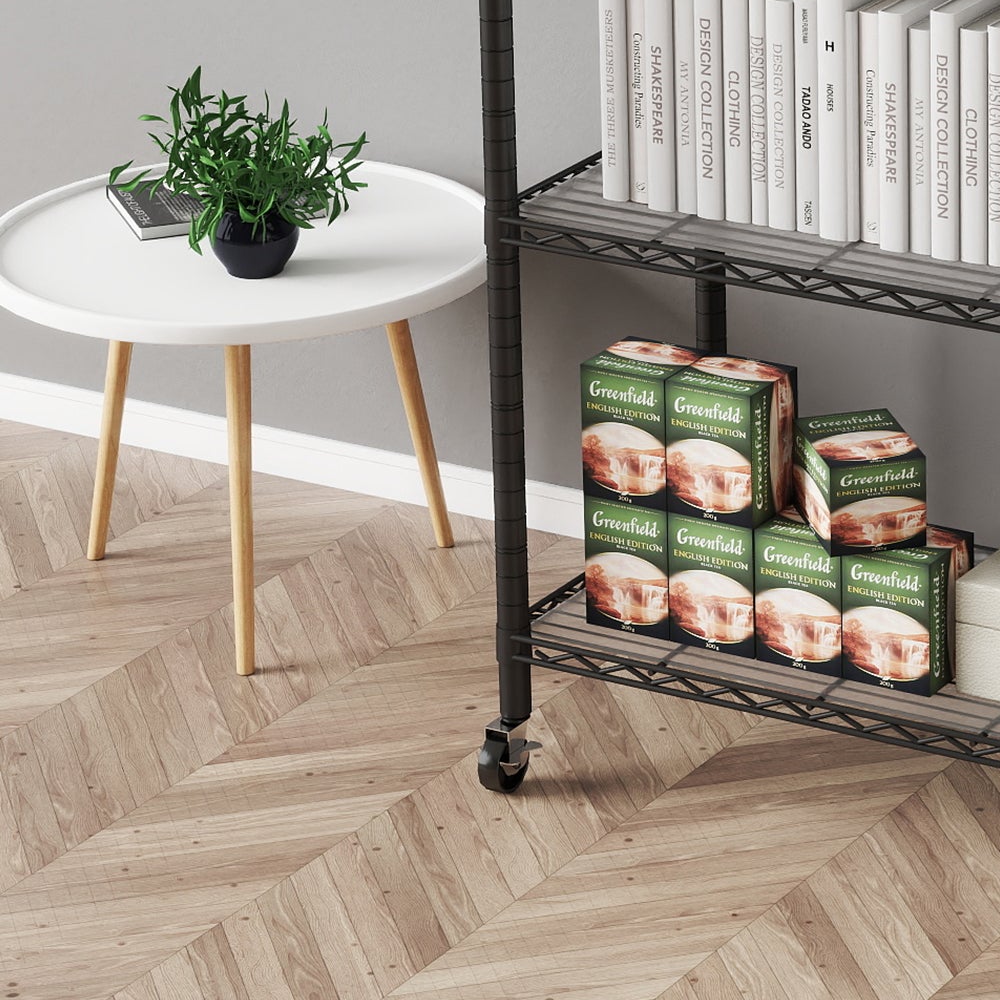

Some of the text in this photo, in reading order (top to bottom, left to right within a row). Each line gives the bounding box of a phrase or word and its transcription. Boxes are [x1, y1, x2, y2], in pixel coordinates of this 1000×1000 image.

[632, 32, 643, 90] Constructing
[680, 60, 689, 82] MY
[605, 9, 616, 168] THE THREE MUSKETEERS
[651, 45, 663, 145] SHAKESPEARE
[699, 18, 713, 179] DESIGN COLLECTION
[826, 83, 834, 112] HOUSES
[864, 69, 876, 127] Constructing
[728, 70, 741, 148] CLOTHING
[750, 35, 767, 184] DESIGN COLLECTION
[772, 43, 785, 190] DESIGN COLLECTION
[801, 86, 812, 150] TADAO ANDO
[885, 82, 897, 184] SHAKESPEARE
[915, 98, 924, 186] MY ANTONIA
[936, 54, 949, 220] DESIGN COLLECTION
[965, 108, 978, 187] CLOTHING
[804, 200, 812, 226] TASCEN
[589, 380, 657, 407] Greenfield
[586, 401, 661, 422] ENGLISH EDITION
[674, 396, 743, 424] Greenfield
[808, 413, 882, 429] Greenfield
[671, 418, 747, 439] ENGLISH EDITION
[836, 488, 877, 497] ENGLISH
[880, 482, 921, 491] EDITION
[840, 467, 917, 487] Greenfield
[592, 510, 660, 538] Greenfield
[589, 531, 663, 553] ENGLISH EDITION
[676, 527, 745, 556] Greenfield
[673, 548, 749, 571] ENGLISH EDITION
[763, 545, 833, 574] Greenfield
[760, 566, 836, 589] ENGLISH EDITION
[850, 563, 921, 592] Greenfield
[847, 585, 925, 607] ENGLISH EDITION
